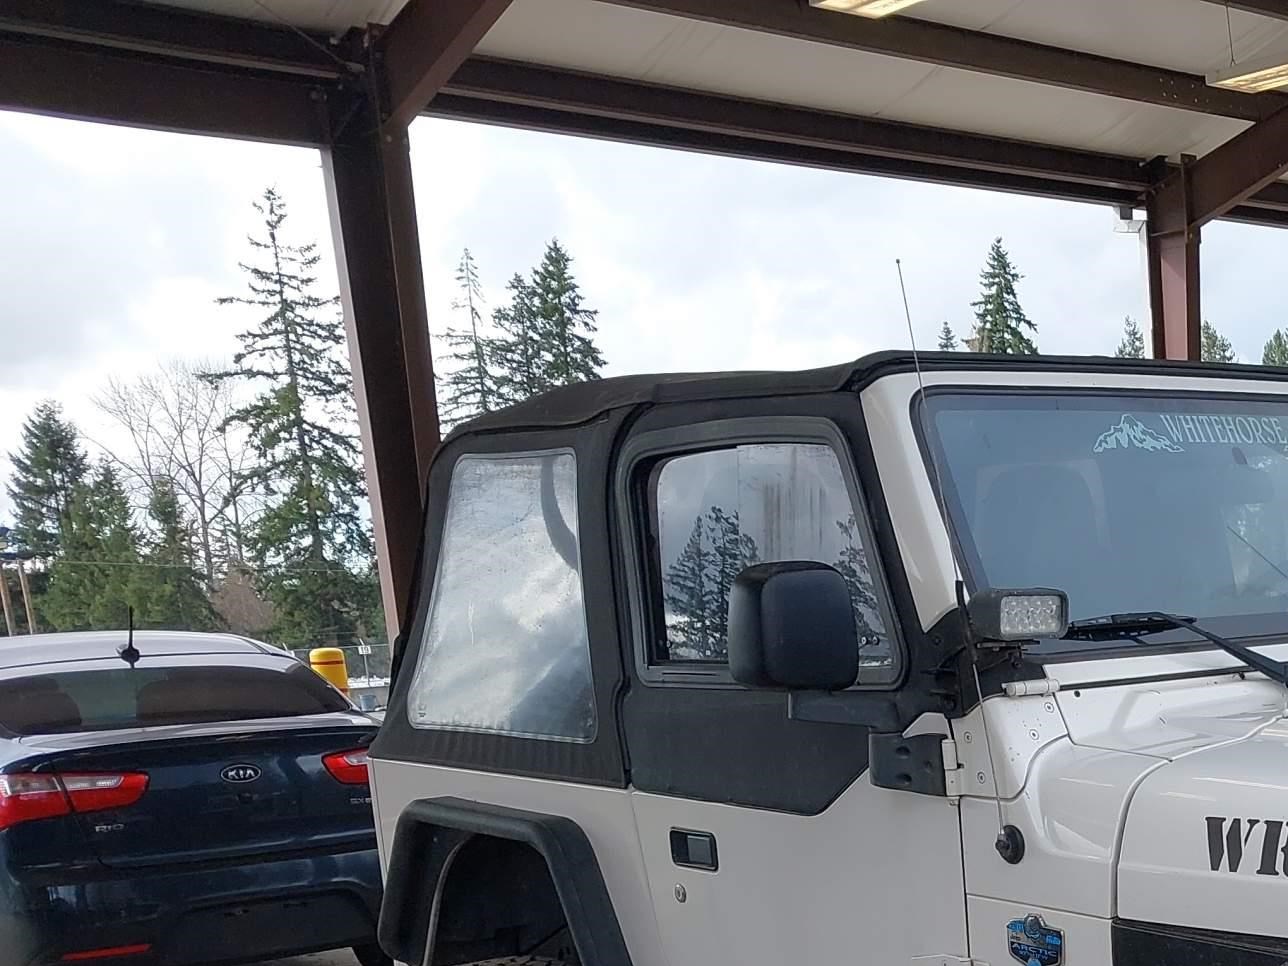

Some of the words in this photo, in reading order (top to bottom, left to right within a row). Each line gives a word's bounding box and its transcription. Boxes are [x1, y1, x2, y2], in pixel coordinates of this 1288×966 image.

[1160, 414, 1287, 444] WHITEHORSE
[228, 769, 255, 779] KIA
[95, 824, 124, 833] RIO
